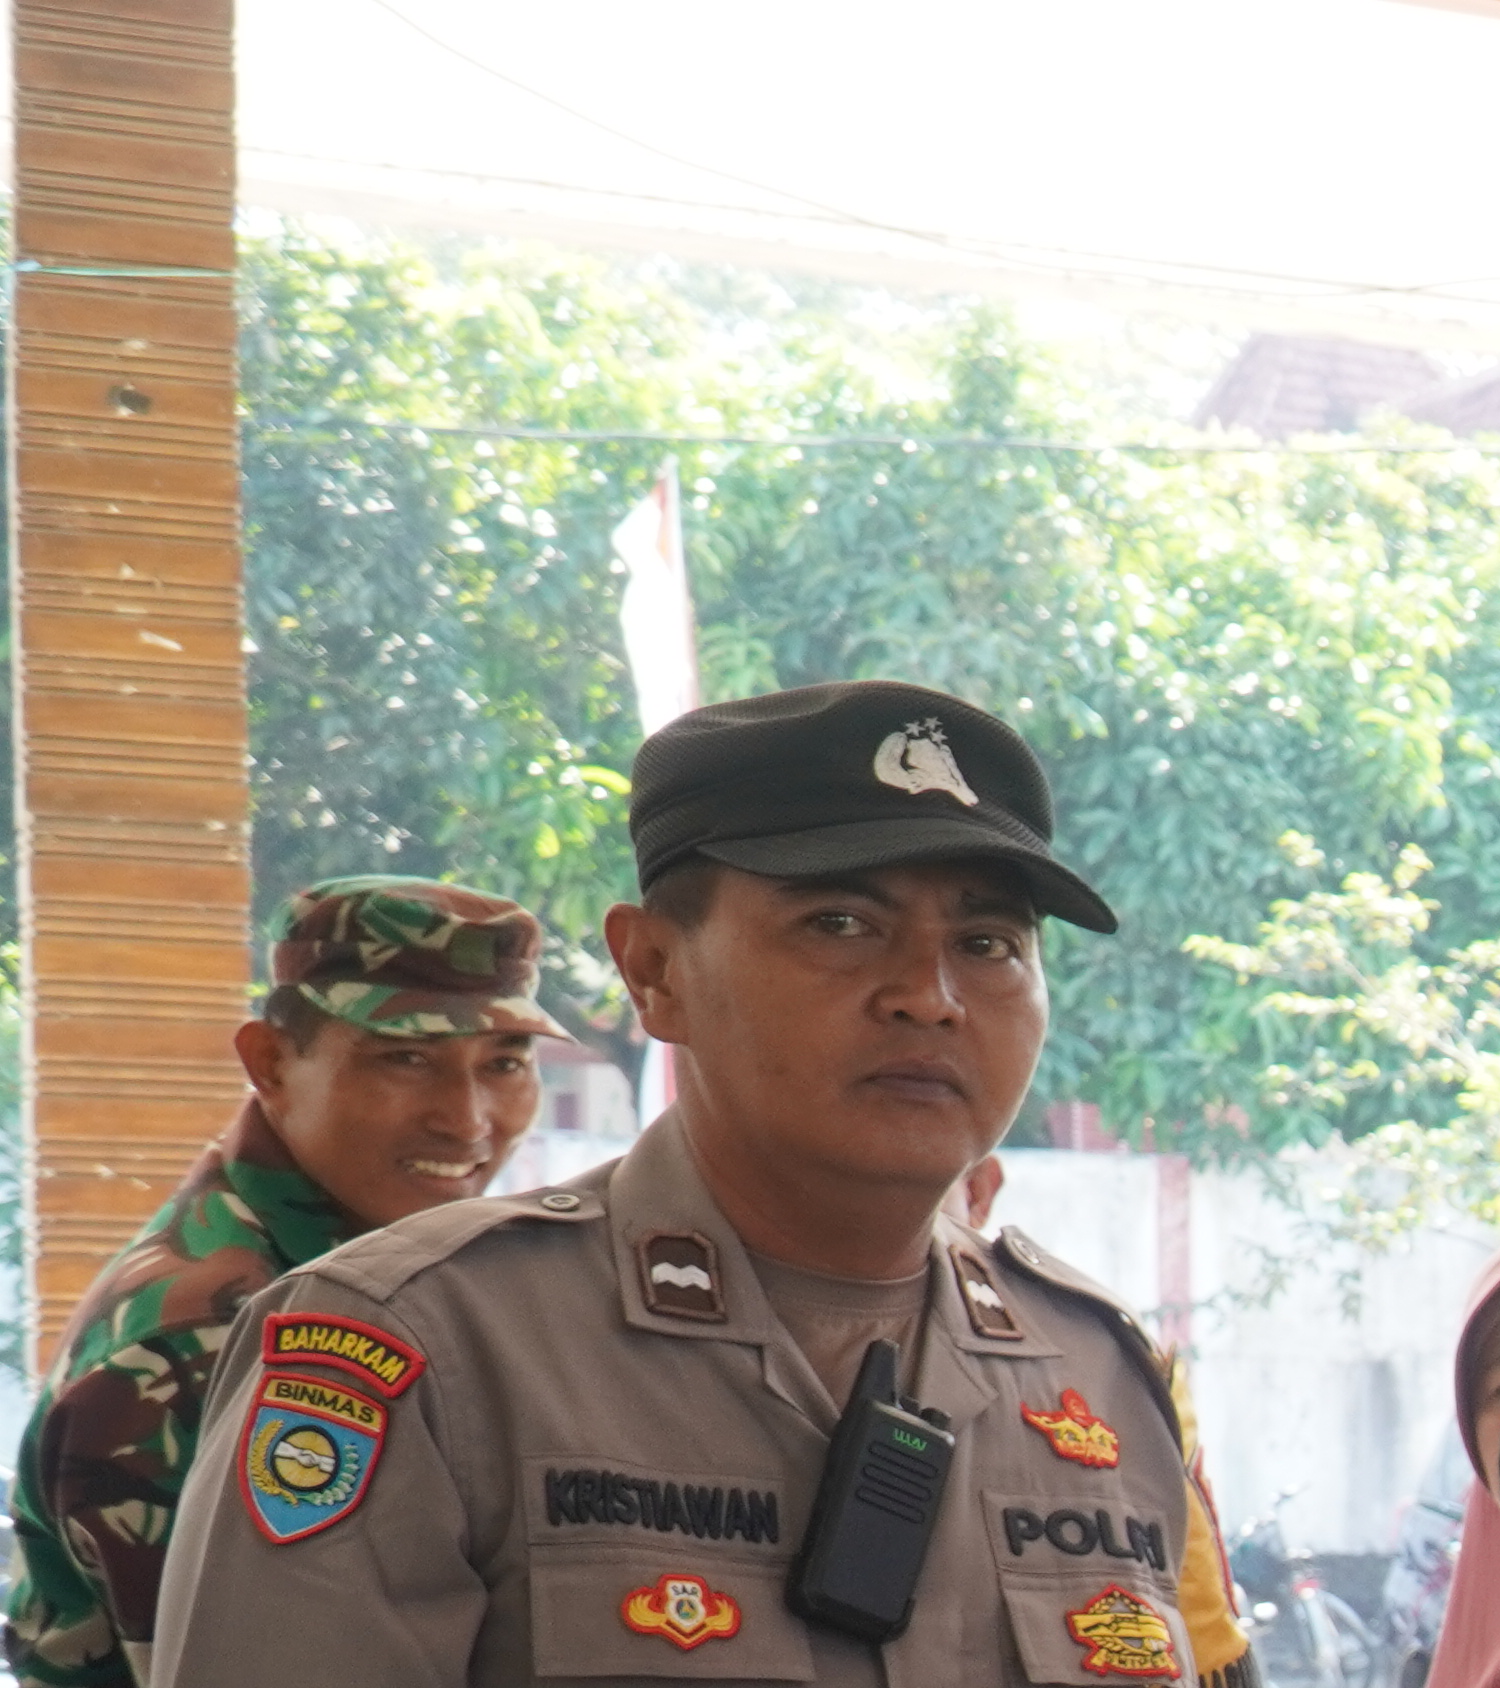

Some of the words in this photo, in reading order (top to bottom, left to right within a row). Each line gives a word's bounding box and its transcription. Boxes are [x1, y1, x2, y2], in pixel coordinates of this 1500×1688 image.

[279, 1326, 406, 1383] BAHARKAM
[275, 1381, 375, 1424] BINMAS
[545, 1467, 779, 1544] KRISTIAWAN
